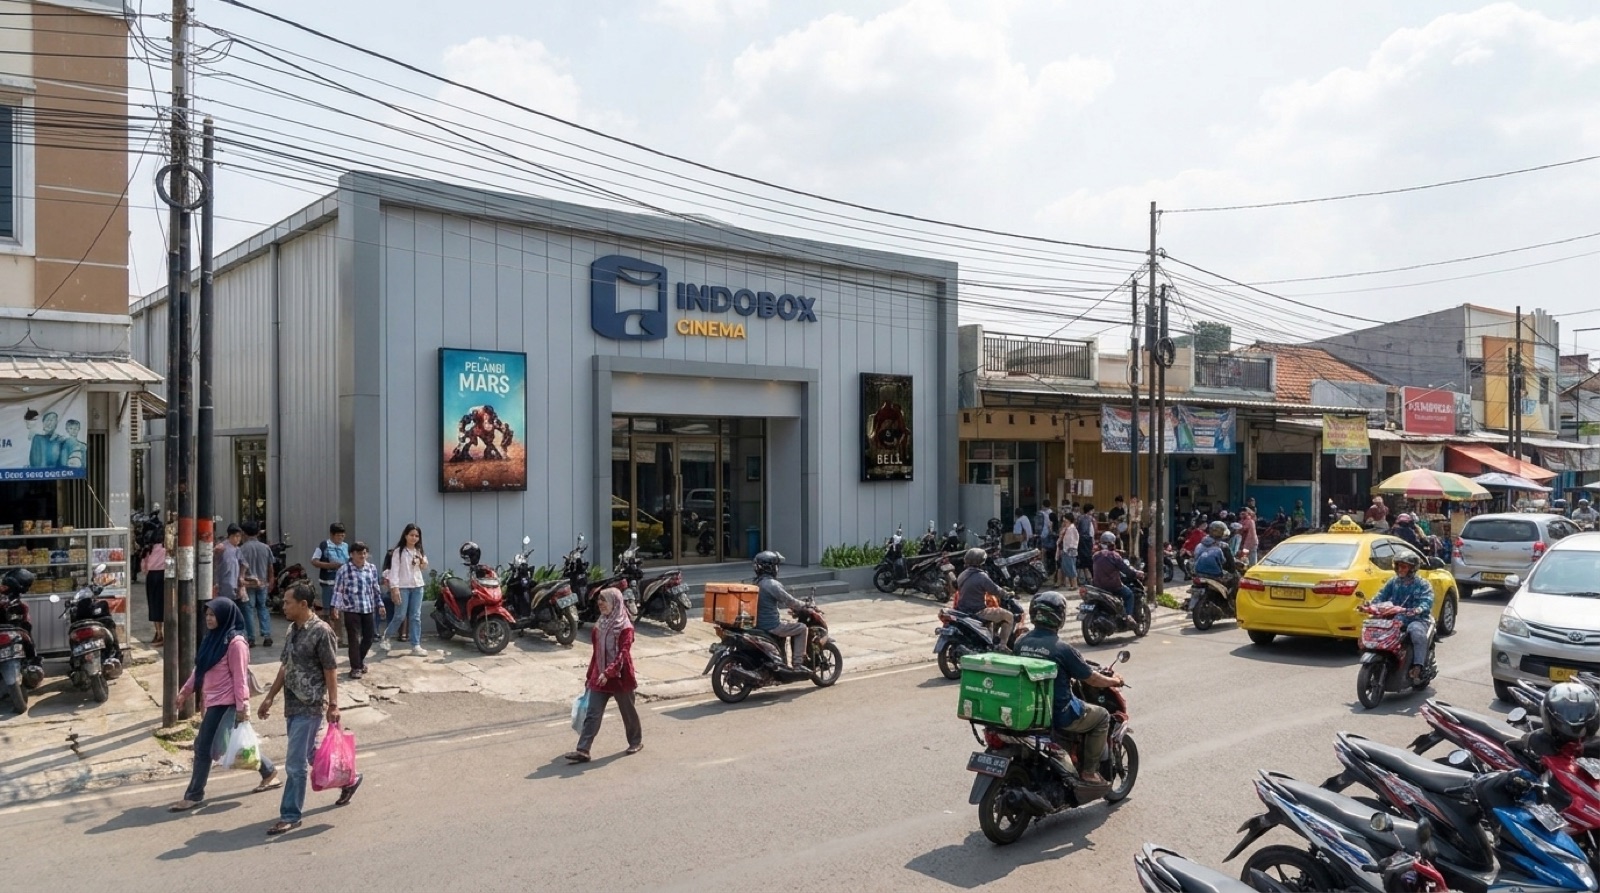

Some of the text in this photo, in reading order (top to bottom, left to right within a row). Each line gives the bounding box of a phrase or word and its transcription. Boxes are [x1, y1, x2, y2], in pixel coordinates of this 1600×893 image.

[676, 282, 818, 322] INDOBOX
[676, 319, 746, 339] CINEMA
[459, 372, 510, 394] MARS
